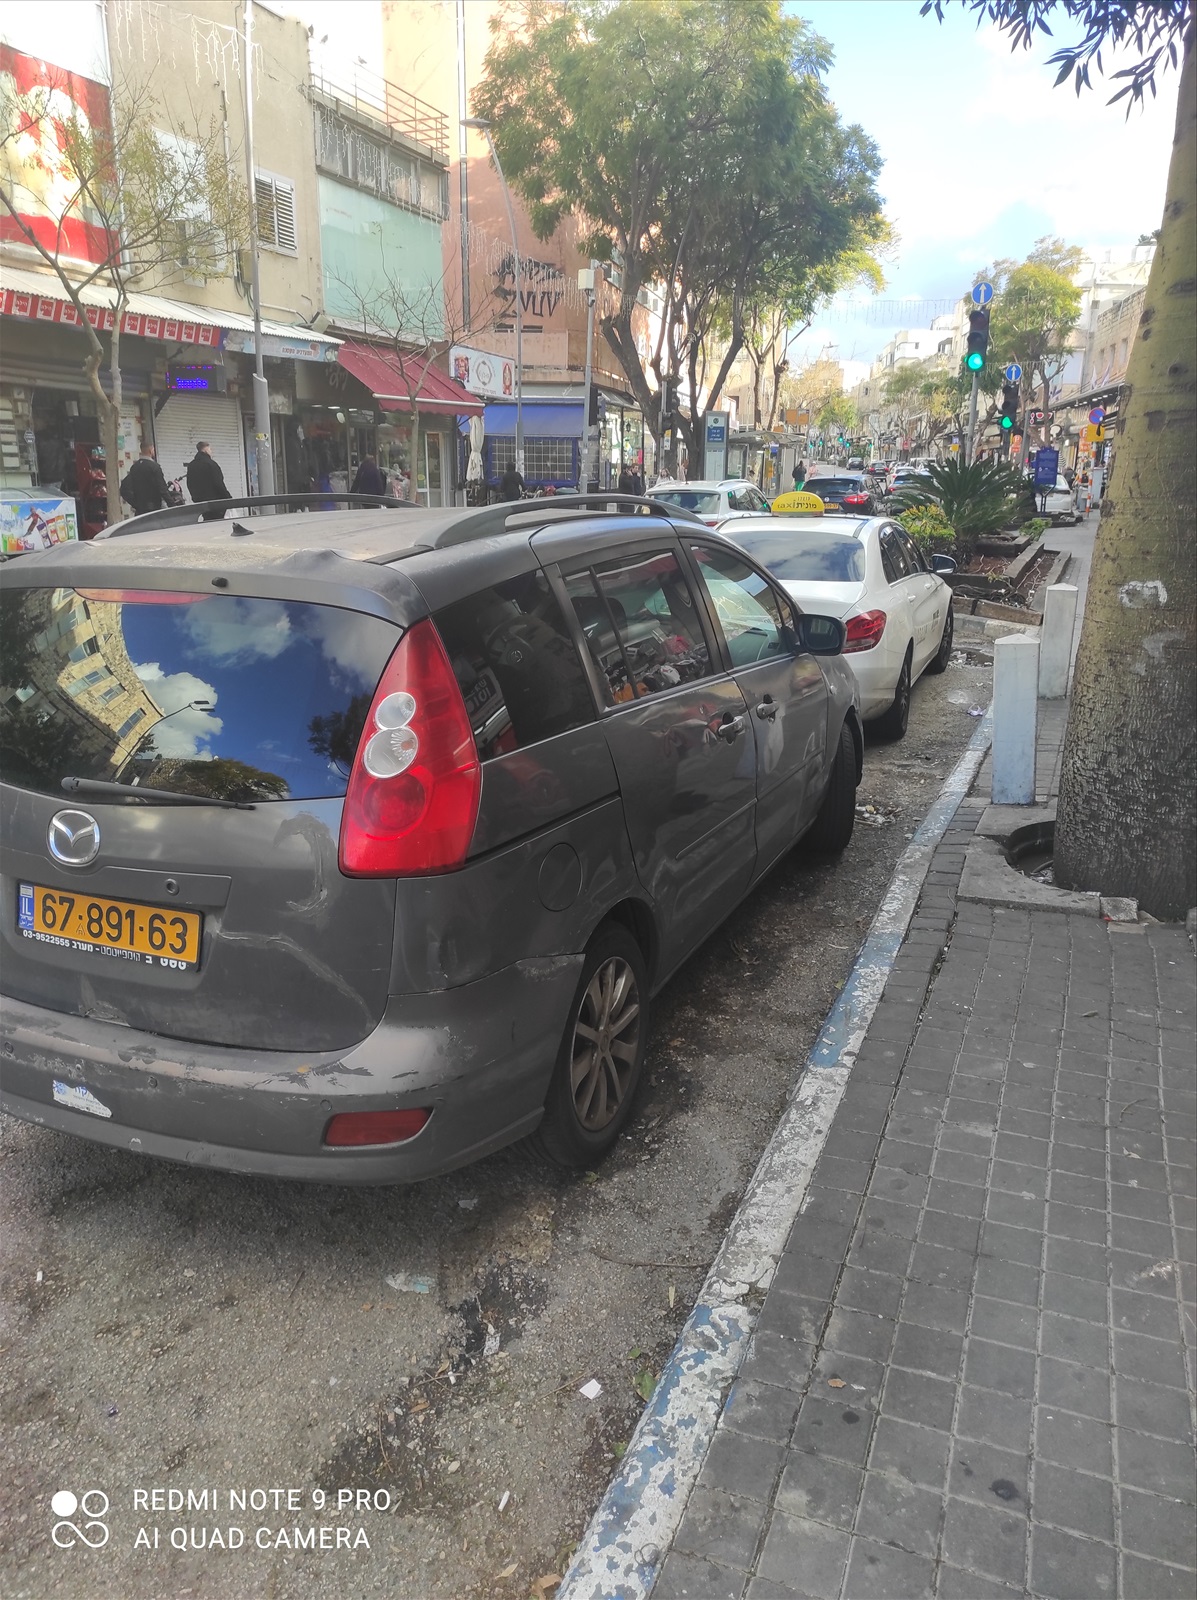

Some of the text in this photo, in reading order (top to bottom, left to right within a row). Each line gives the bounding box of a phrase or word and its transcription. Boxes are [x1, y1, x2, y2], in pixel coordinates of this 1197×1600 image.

[778, 500, 796, 508] taxi
[22, 897, 31, 915] IL
[23, 930, 70, 948] 03-9522555
[72, 940, 94, 952] מערב
